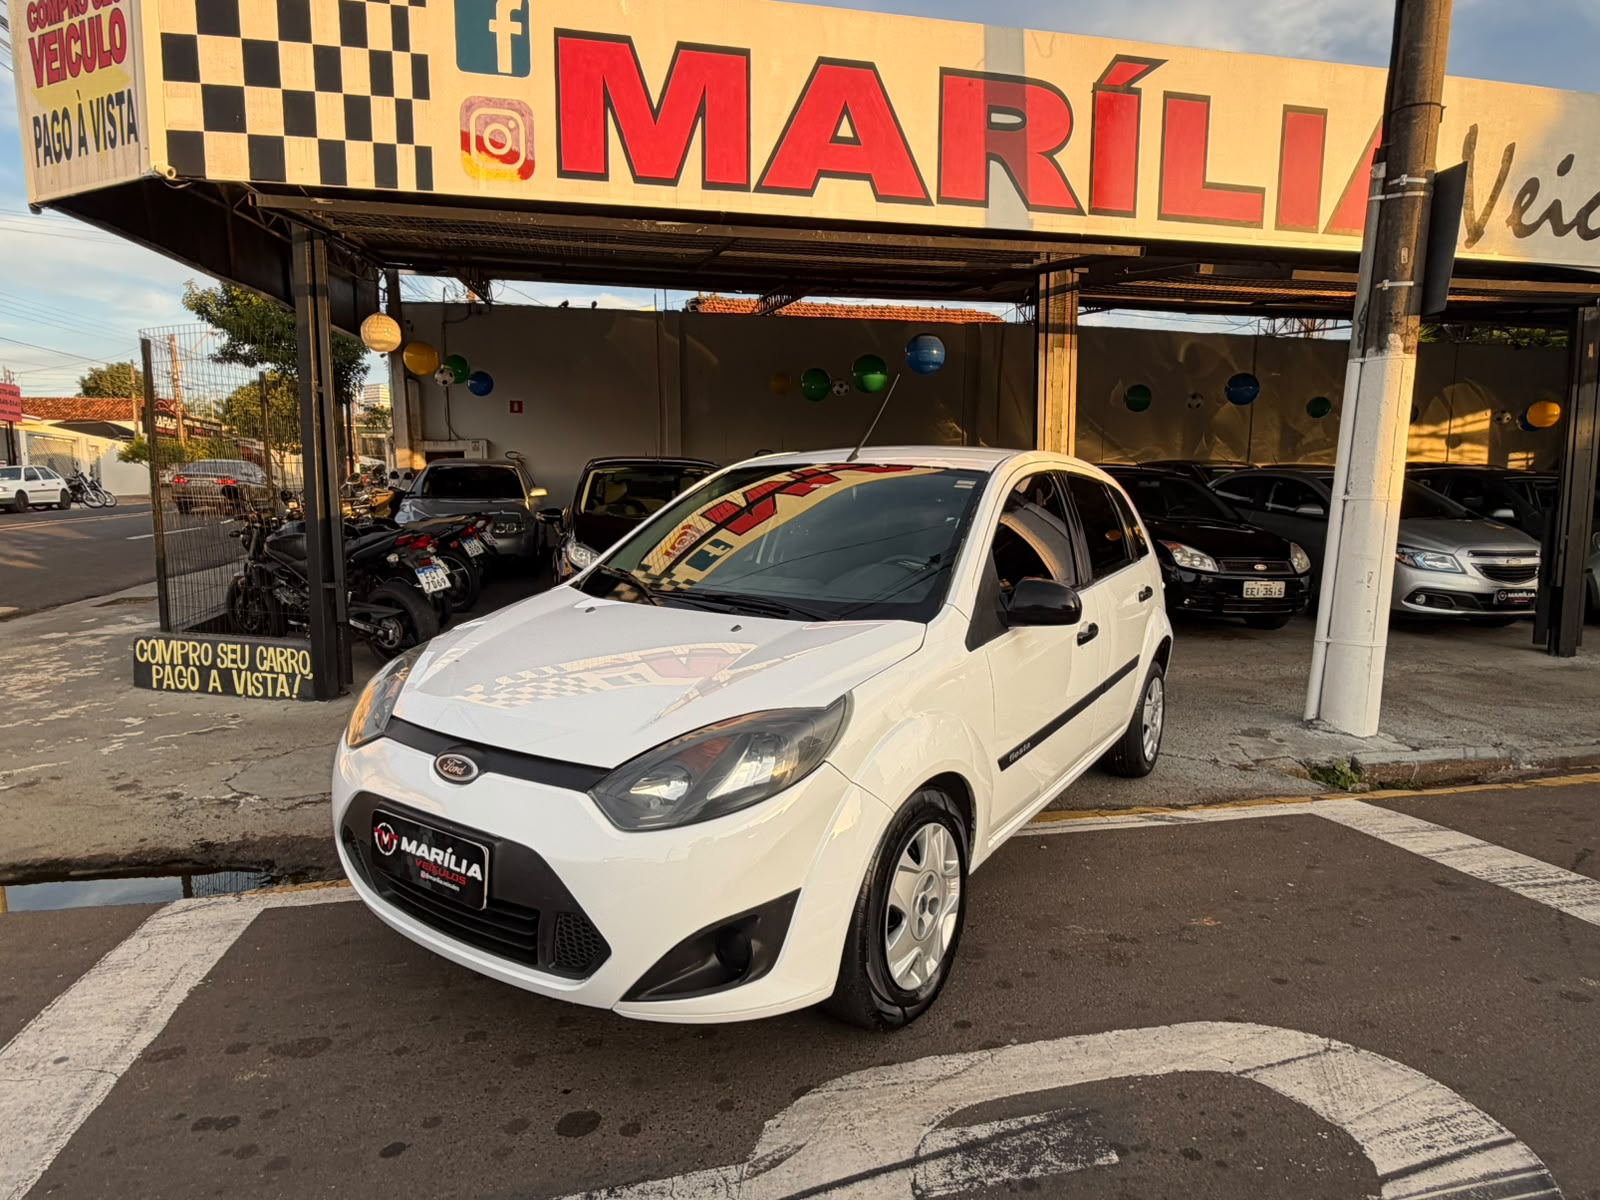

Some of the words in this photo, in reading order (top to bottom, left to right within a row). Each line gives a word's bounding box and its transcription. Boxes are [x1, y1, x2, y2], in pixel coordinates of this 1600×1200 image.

[33, 107, 72, 168] PAGO
[77, 89, 88, 157] À
[90, 88, 138, 153] VISTA
[135, 639, 212, 666] COMPRO
[216, 643, 249, 669] SEU
[152, 665, 200, 691] PAGO
[208, 669, 223, 693] A
[232, 669, 301, 698] VISTA!
[443, 758, 467, 776] Ford
[401, 836, 483, 881] MARÍLIA
